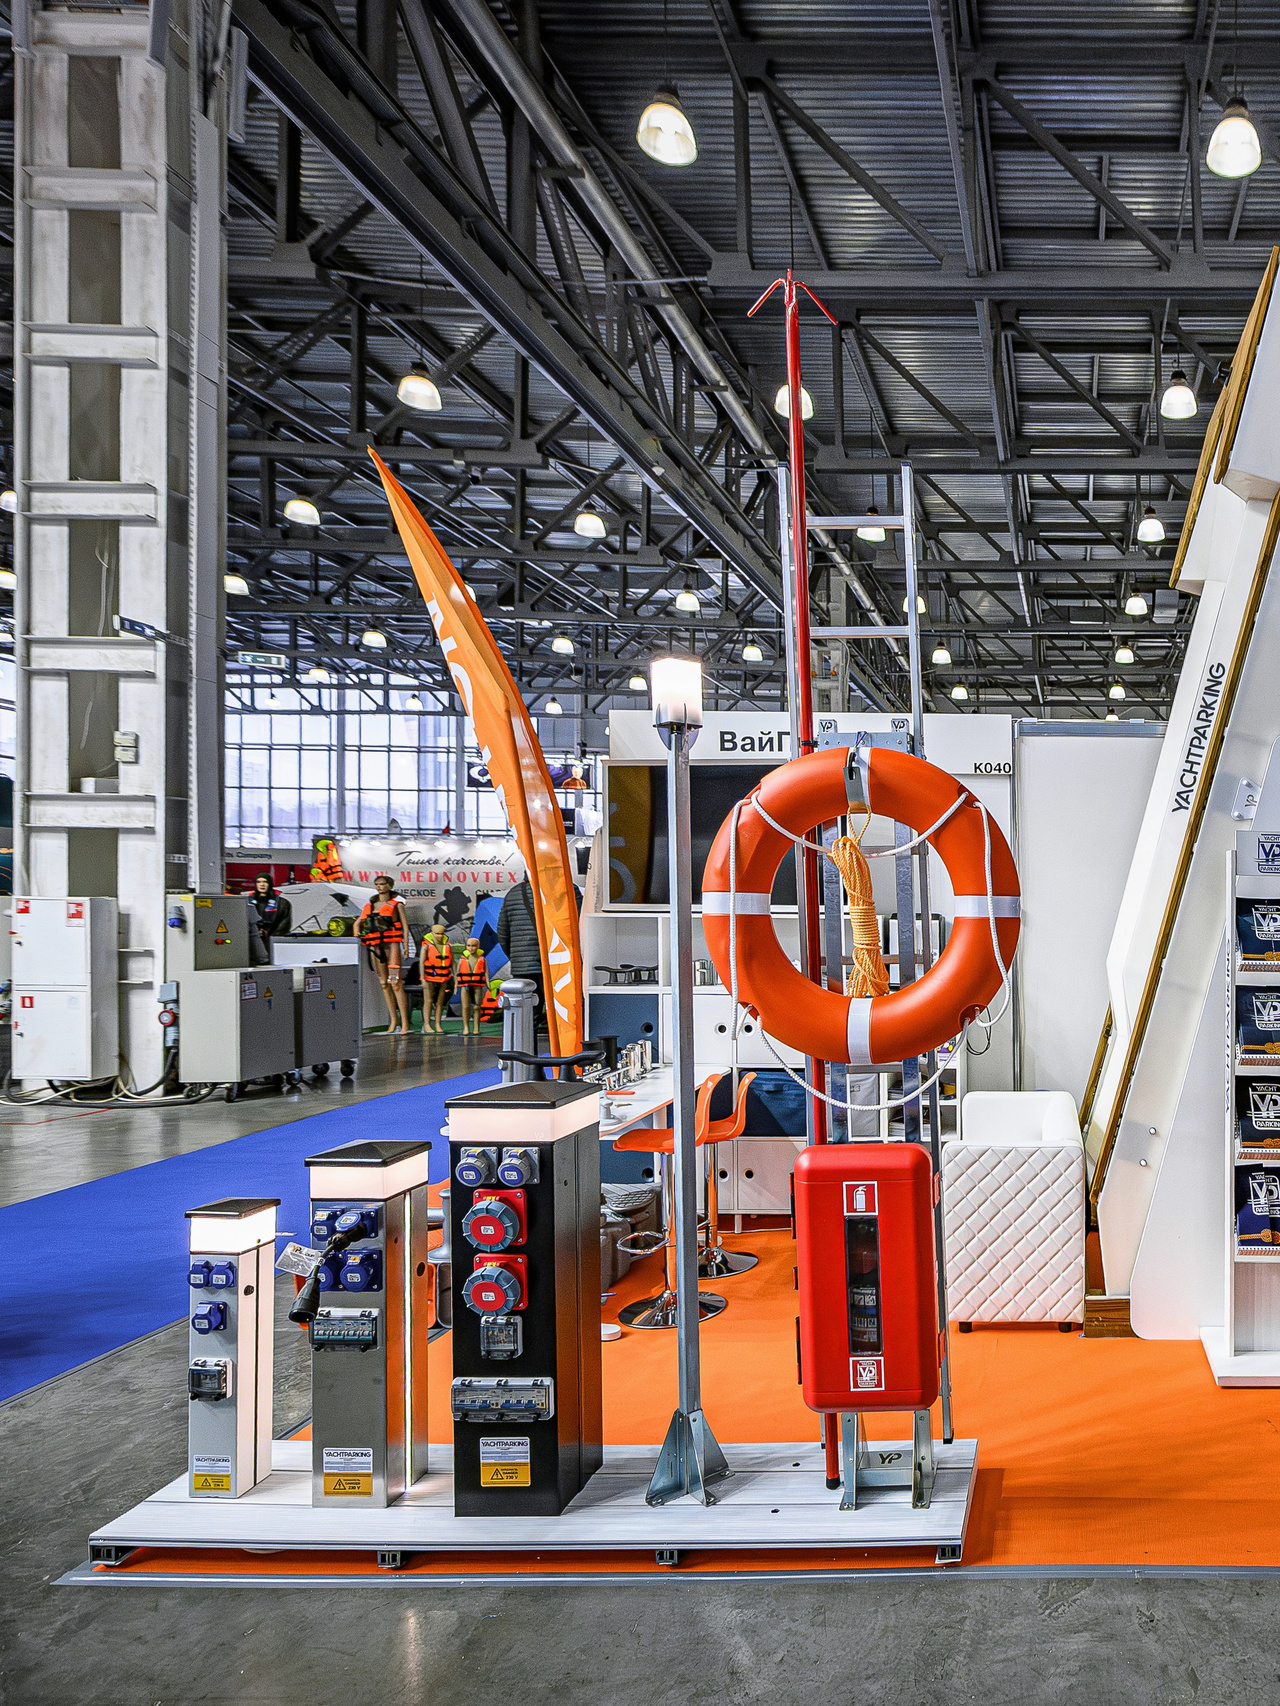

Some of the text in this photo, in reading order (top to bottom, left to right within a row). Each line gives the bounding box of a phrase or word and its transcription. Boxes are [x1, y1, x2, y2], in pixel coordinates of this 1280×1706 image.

[1171, 662, 1226, 813] YACHTPARKING
[973, 762, 1012, 774] K040
[878, 1452, 903, 1465] YP
